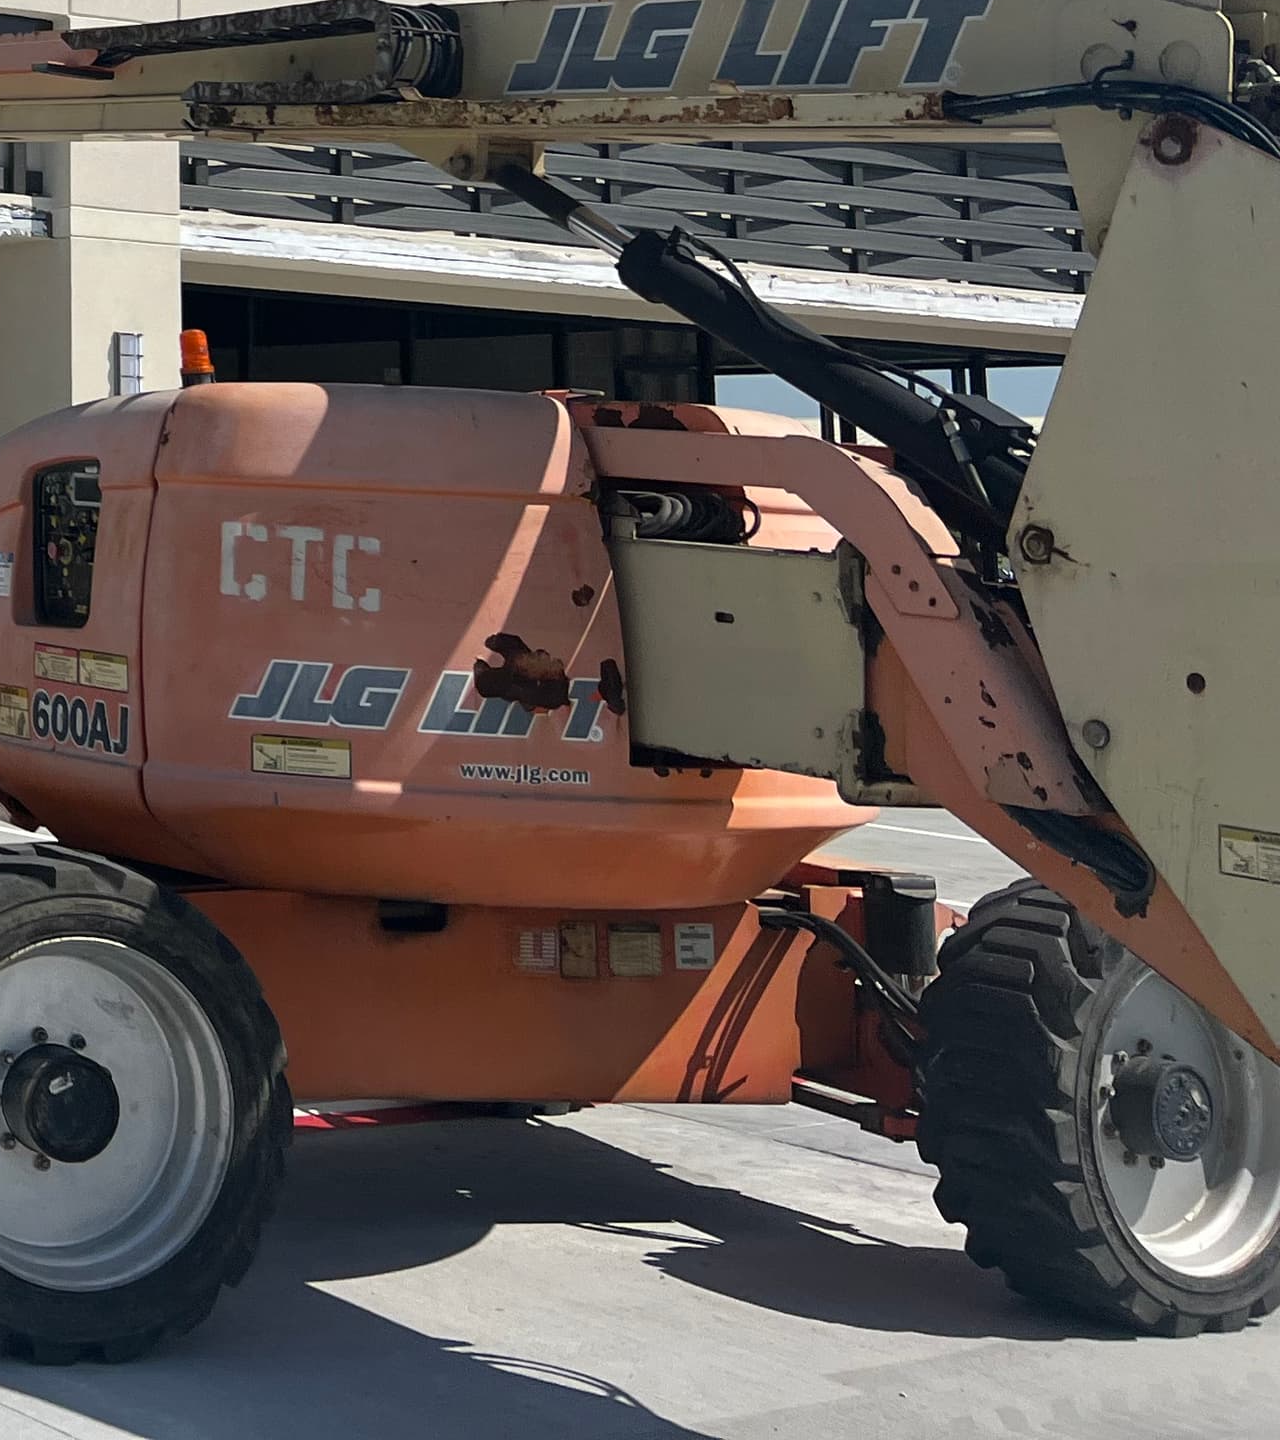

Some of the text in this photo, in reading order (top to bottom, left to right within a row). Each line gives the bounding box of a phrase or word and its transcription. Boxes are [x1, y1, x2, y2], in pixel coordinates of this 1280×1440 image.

[220, 521, 381, 612] CTC
[32, 688, 129, 756] 600AJ
[227, 659, 413, 731] JLG
[460, 763, 589, 785] www.jlg.com
